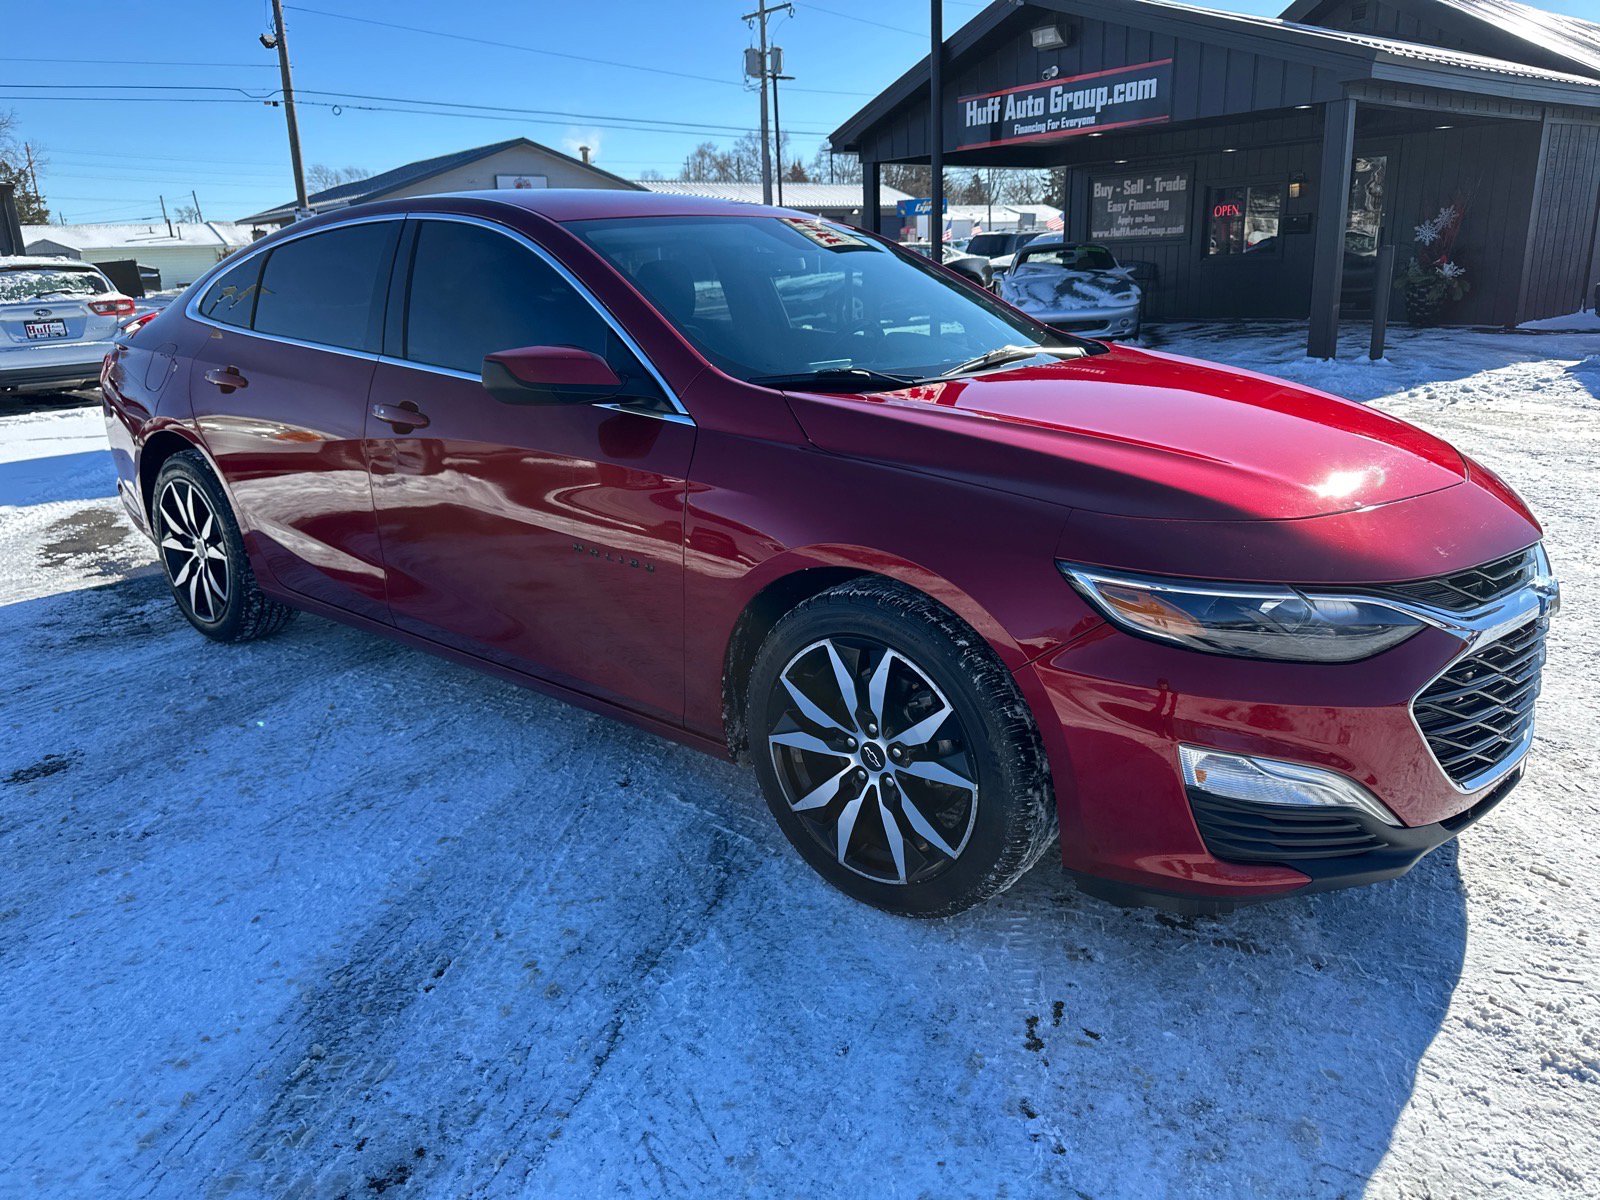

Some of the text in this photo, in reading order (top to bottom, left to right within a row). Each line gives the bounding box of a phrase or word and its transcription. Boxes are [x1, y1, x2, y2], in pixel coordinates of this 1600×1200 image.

[966, 77, 1158, 127] Huff Auto Group.com
[1014, 115, 1095, 135] Financing For Everyone
[1093, 182, 1114, 199] Buy
[1123, 178, 1144, 195] Sell
[1154, 175, 1187, 193] Trade
[1107, 197, 1169, 214] Easy Financing
[1214, 204, 1240, 217] OPEN
[1117, 215, 1134, 225] Apply
[1092, 225, 1184, 238] www.HuffAutoGroup.com
[27, 324, 52, 334] Huff
